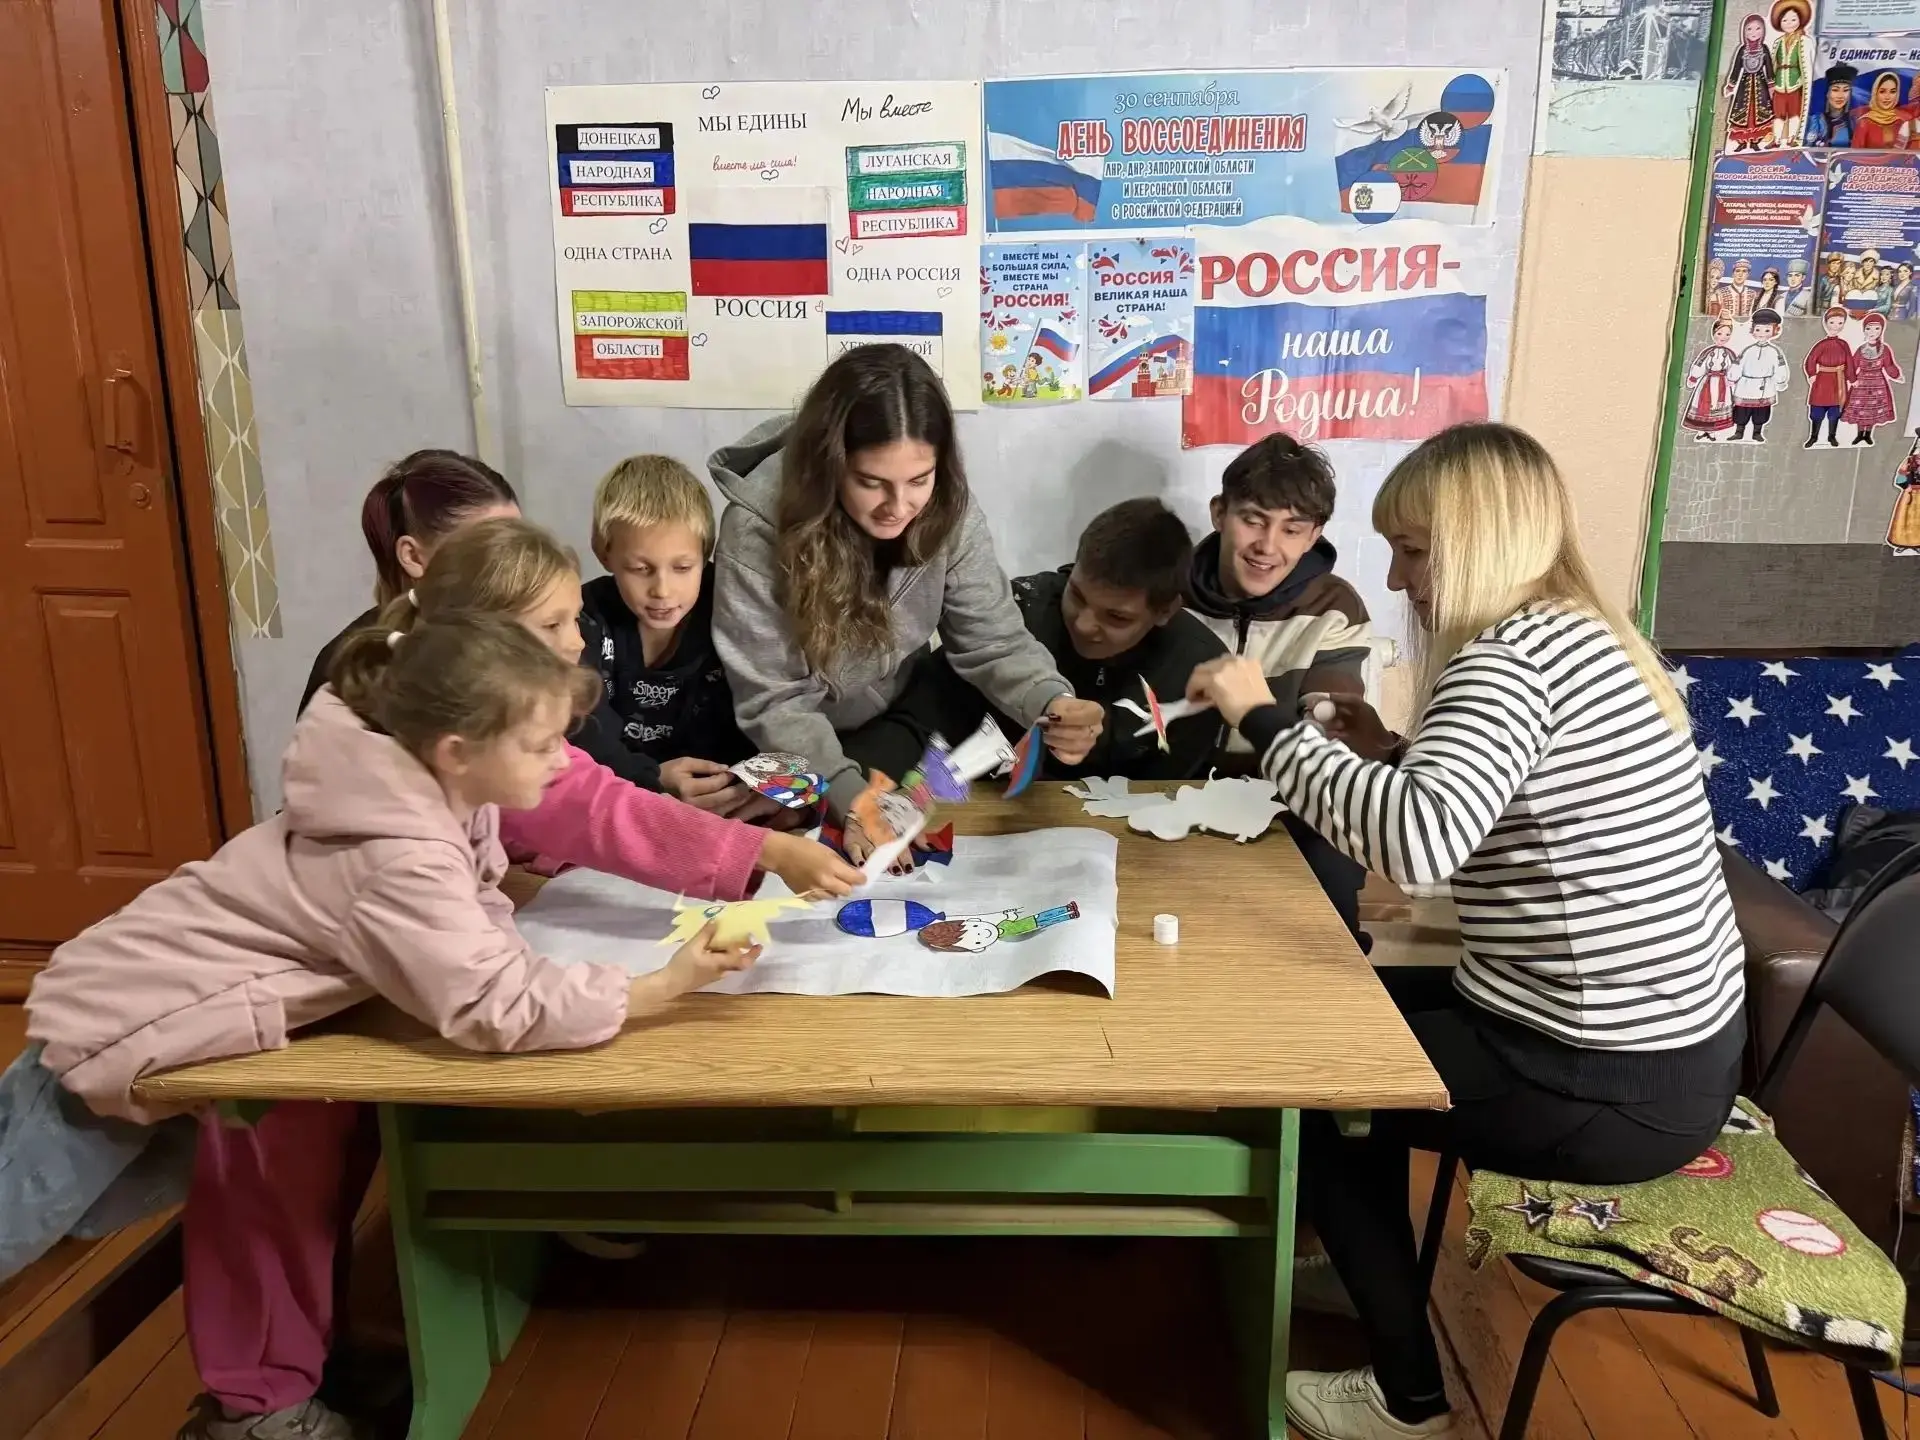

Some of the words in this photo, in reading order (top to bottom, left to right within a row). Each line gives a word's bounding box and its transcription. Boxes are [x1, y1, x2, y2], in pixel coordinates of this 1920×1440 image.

[1840, 49, 1897, 61] единстве
[1114, 92, 1138, 114] 30
[1143, 80, 1240, 114] сентября
[841, 97, 872, 122] Мы
[698, 115, 732, 132] МЫ
[738, 112, 808, 134] ЕДИНЫ
[579, 132, 657, 147] ДОНЕЦКАЯ
[1057, 119, 1114, 161] ДЕНЬ
[1121, 115, 1308, 157] ВОССОЕДИНЕНИЯ
[865, 153, 952, 168] ЛУГАНСКАЯ
[576, 166, 652, 179] НАРОДНАЯ
[1104, 162, 1126, 178] ЛНР,
[1214, 159, 1255, 174] ОБЛАСТИ
[1748, 165, 1785, 174] РОССИЯ
[867, 185, 945, 200] НАРОДНАЯ
[1124, 183, 1130, 196] И
[1192, 181, 1232, 195] ОБЛАСТИ
[573, 194, 663, 208] РЕСПУБЛИКА
[1112, 205, 1119, 218] С
[1123, 200, 1181, 218] РОССИЙСКОЙ
[1184, 198, 1243, 217] ФЕДЕРАЦИЕЙ
[862, 216, 955, 232] РЕСПУБЛИКА
[564, 246, 608, 262] ОДНА
[612, 247, 672, 260] СТРАНА
[1002, 253, 1040, 261] ВМЕСТЕ
[1042, 252, 1059, 260] МЫ
[846, 267, 892, 282] ОДНА
[897, 267, 961, 281] РОССИЯ
[992, 263, 1038, 272] БОЛЬШАЯ
[1041, 262, 1070, 271] СИЛА,
[1002, 273, 1040, 281] ВМЕСТЕ
[1042, 272, 1059, 280] МЫ
[1100, 270, 1174, 287] РОССИЯ
[1012, 283, 1049, 292] СТРАНА
[1094, 290, 1149, 302] ВЕЛИКАЯ
[1152, 288, 1188, 299] НАША
[993, 292, 1070, 309] РОССИЯ!
[1116, 302, 1166, 314] СТРАНА!
[714, 298, 808, 319] РОССИЯ
[580, 315, 684, 330] ЗАПОРОЖСКОЙ
[597, 343, 660, 355] ОБЛАСТИ
[1281, 327, 1394, 360] наша
[1240, 366, 1422, 440] Родина!
